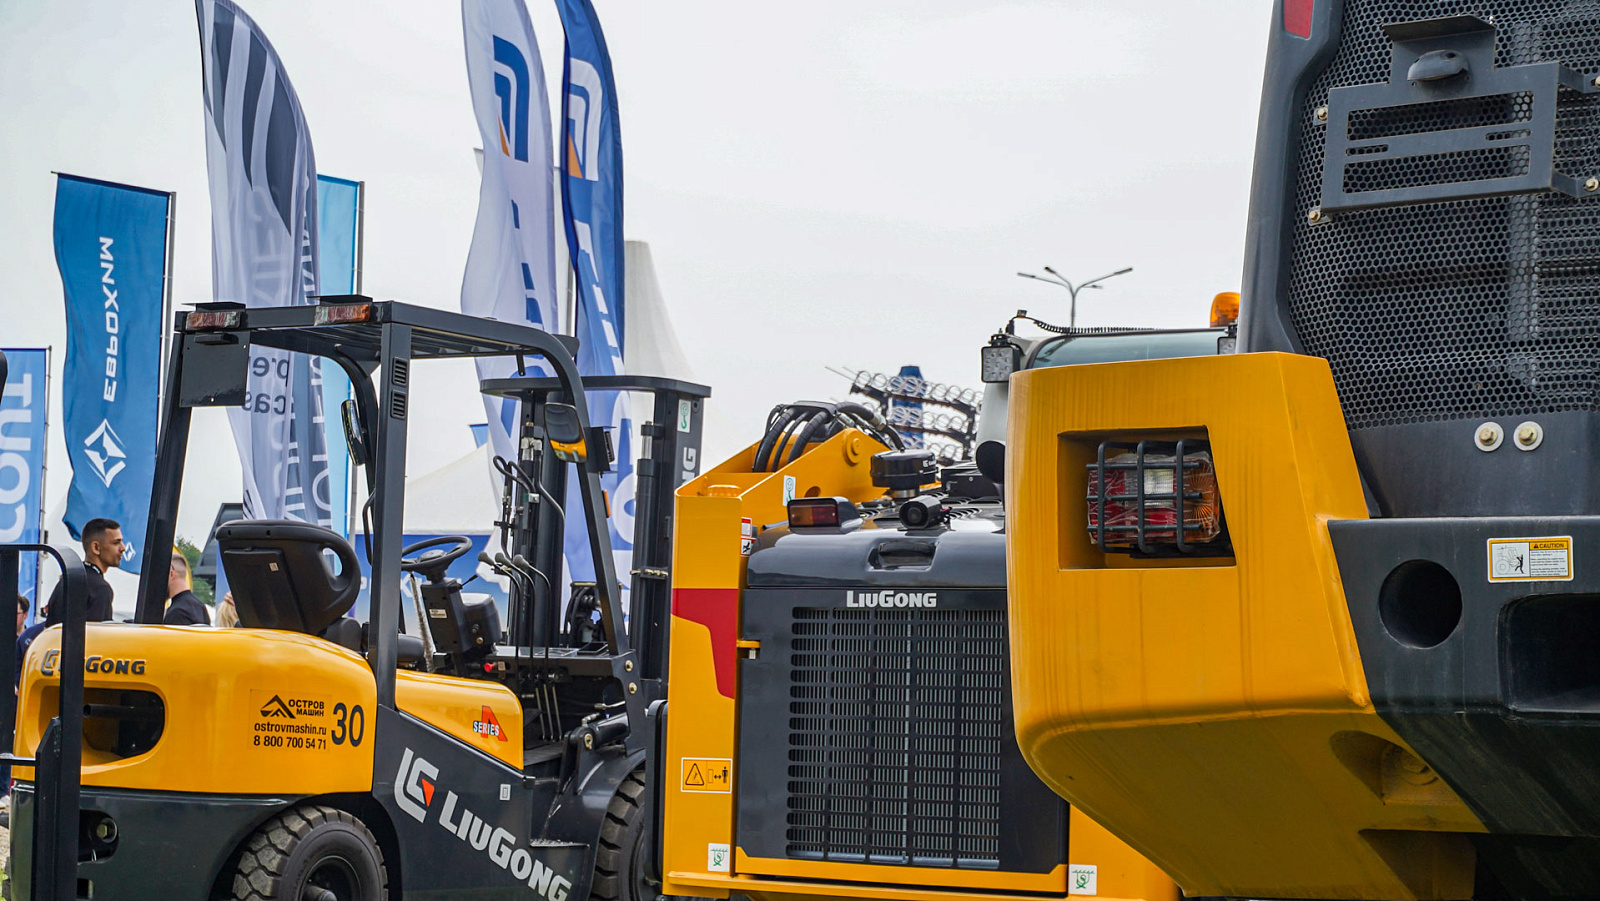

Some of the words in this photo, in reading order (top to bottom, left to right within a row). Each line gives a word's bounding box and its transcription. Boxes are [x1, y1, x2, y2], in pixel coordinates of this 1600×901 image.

[59, 655, 146, 675] GONG
[288, 699, 325, 710] ОСТРОВ
[296, 708, 324, 717] МАШИН
[254, 721, 327, 736] ostrovmashin.ru
[331, 702, 365, 748] 30
[473, 720, 500, 736] SERIES
[253, 735, 260, 746] 8
[263, 735, 283, 748] 800
[286, 736, 303, 749] 700
[305, 738, 315, 749] 54
[318, 739, 326, 750] 71
